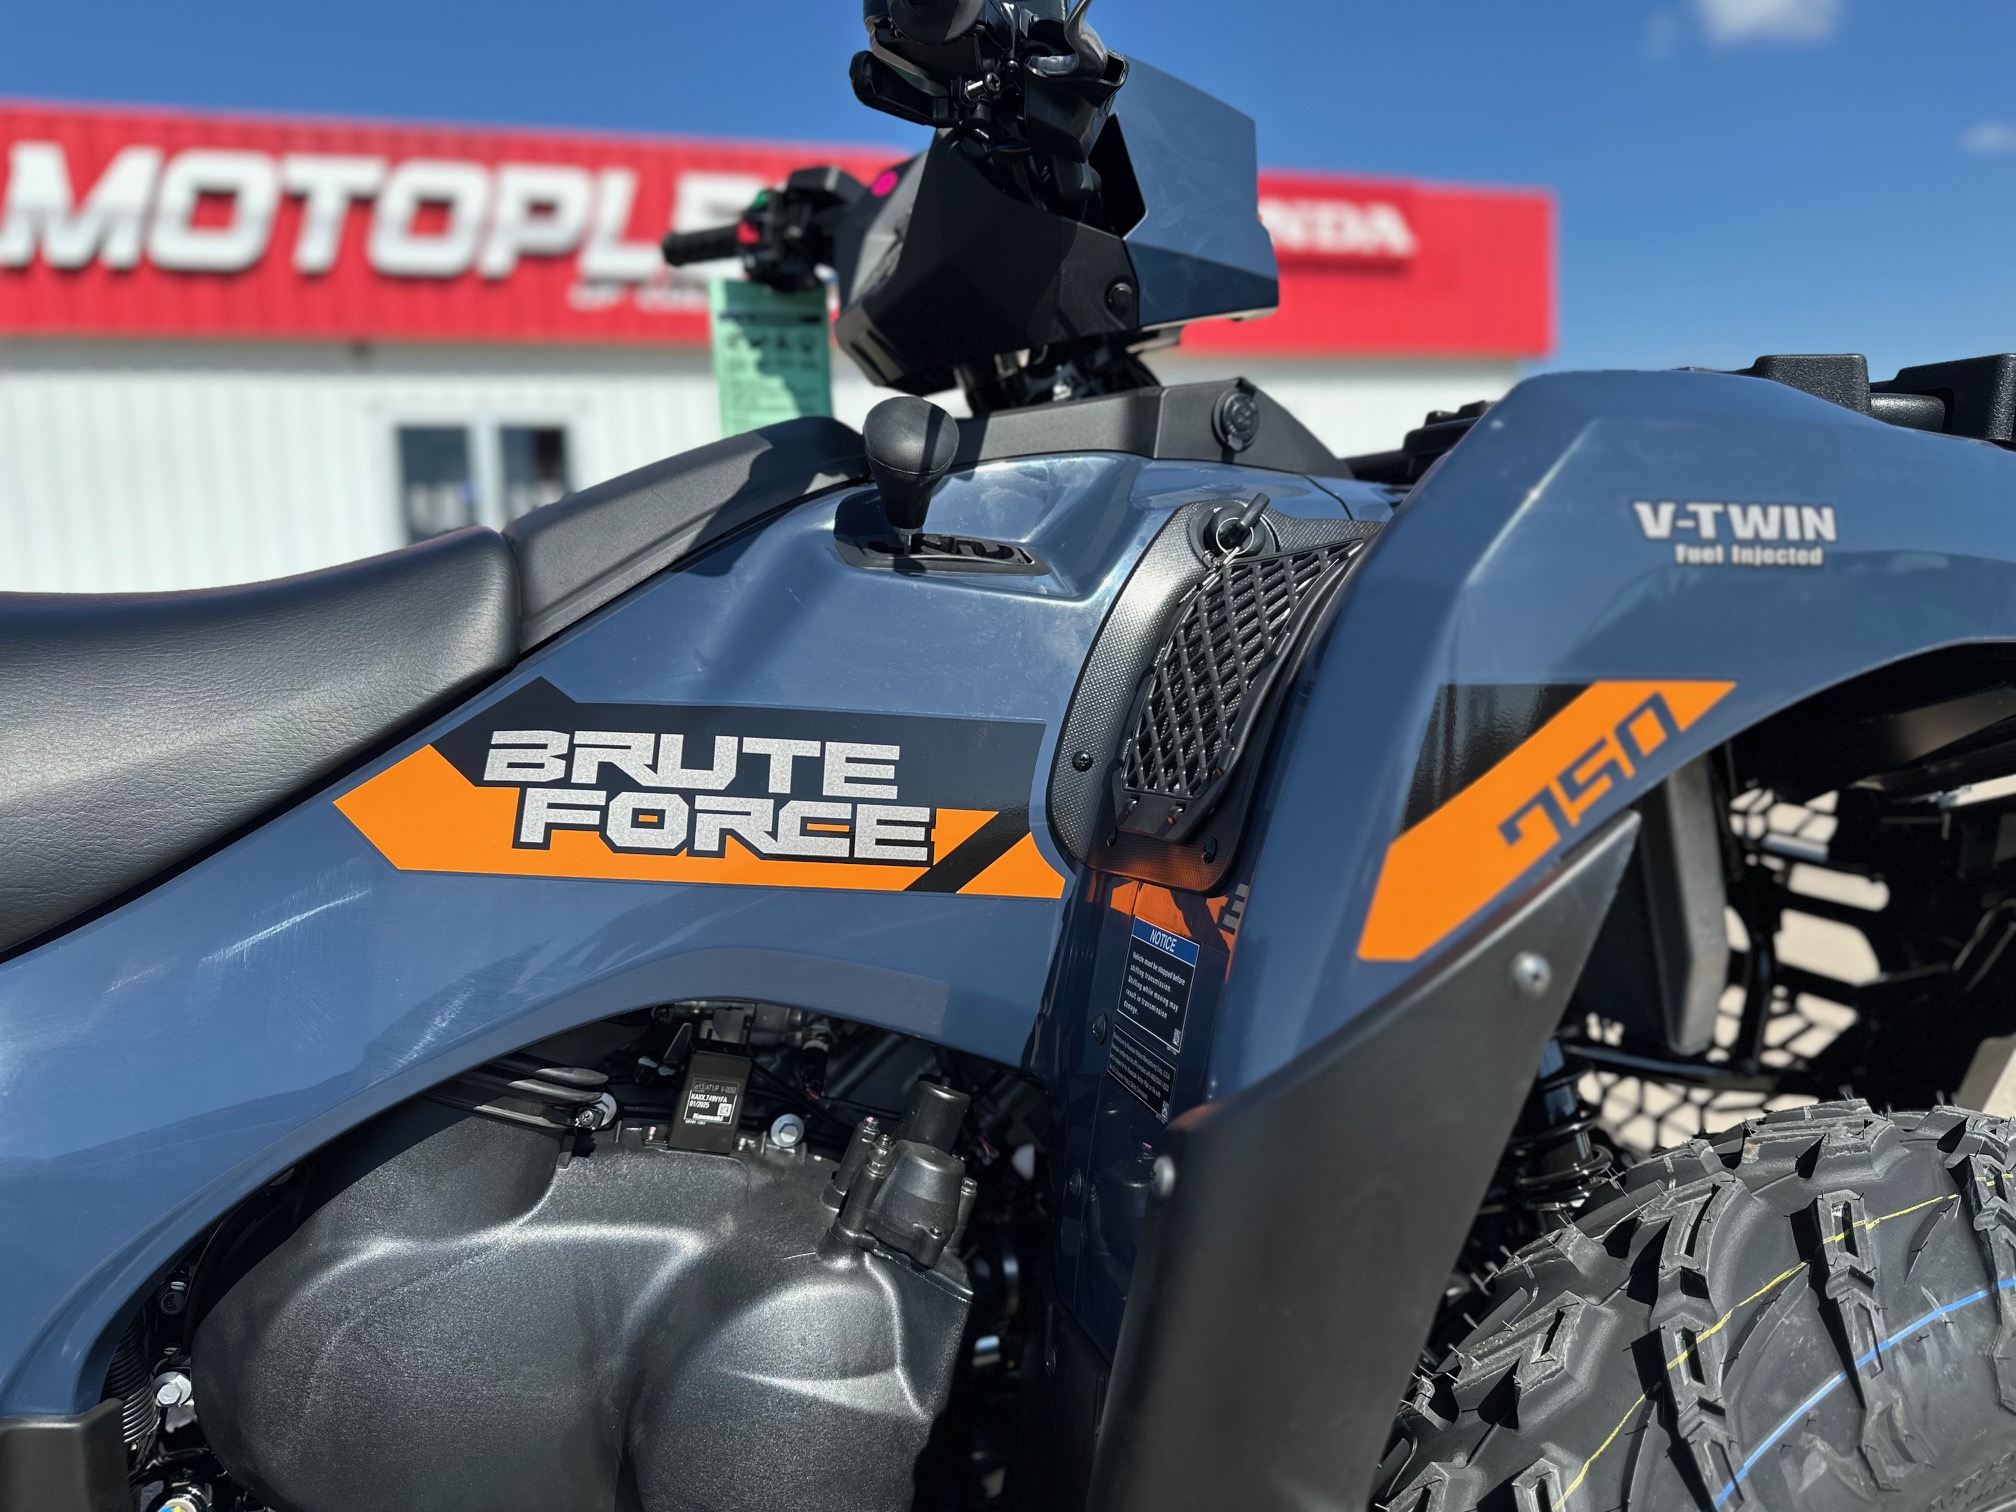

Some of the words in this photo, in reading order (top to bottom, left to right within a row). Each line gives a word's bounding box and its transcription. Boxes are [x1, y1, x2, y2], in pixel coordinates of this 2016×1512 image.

[0, 141, 780, 281] MOTOPLE
[1258, 196, 1420, 257] NDA
[1633, 501, 1837, 541] V-TWIN
[1674, 543, 1724, 564] Fuel
[1731, 544, 1824, 567] Injected
[483, 729, 900, 799] BRUTE
[1498, 691, 1682, 845] 750
[519, 787, 930, 862] FORCE
[1150, 929, 1177, 952] NOTICE
[1130, 964, 1145, 979] shifting
[1132, 951, 1145, 964] Vehicle
[1144, 958, 1154, 969] must
[1158, 966, 1173, 980] stopped
[1172, 973, 1186, 986] before
[1125, 989, 1137, 1000] result
[1141, 997, 1168, 1019] transmission
[1128, 975, 1143, 991] Shifting
[1142, 985, 1153, 997] while
[1154, 992, 1169, 1007] moving
[1169, 1001, 1179, 1013] may
